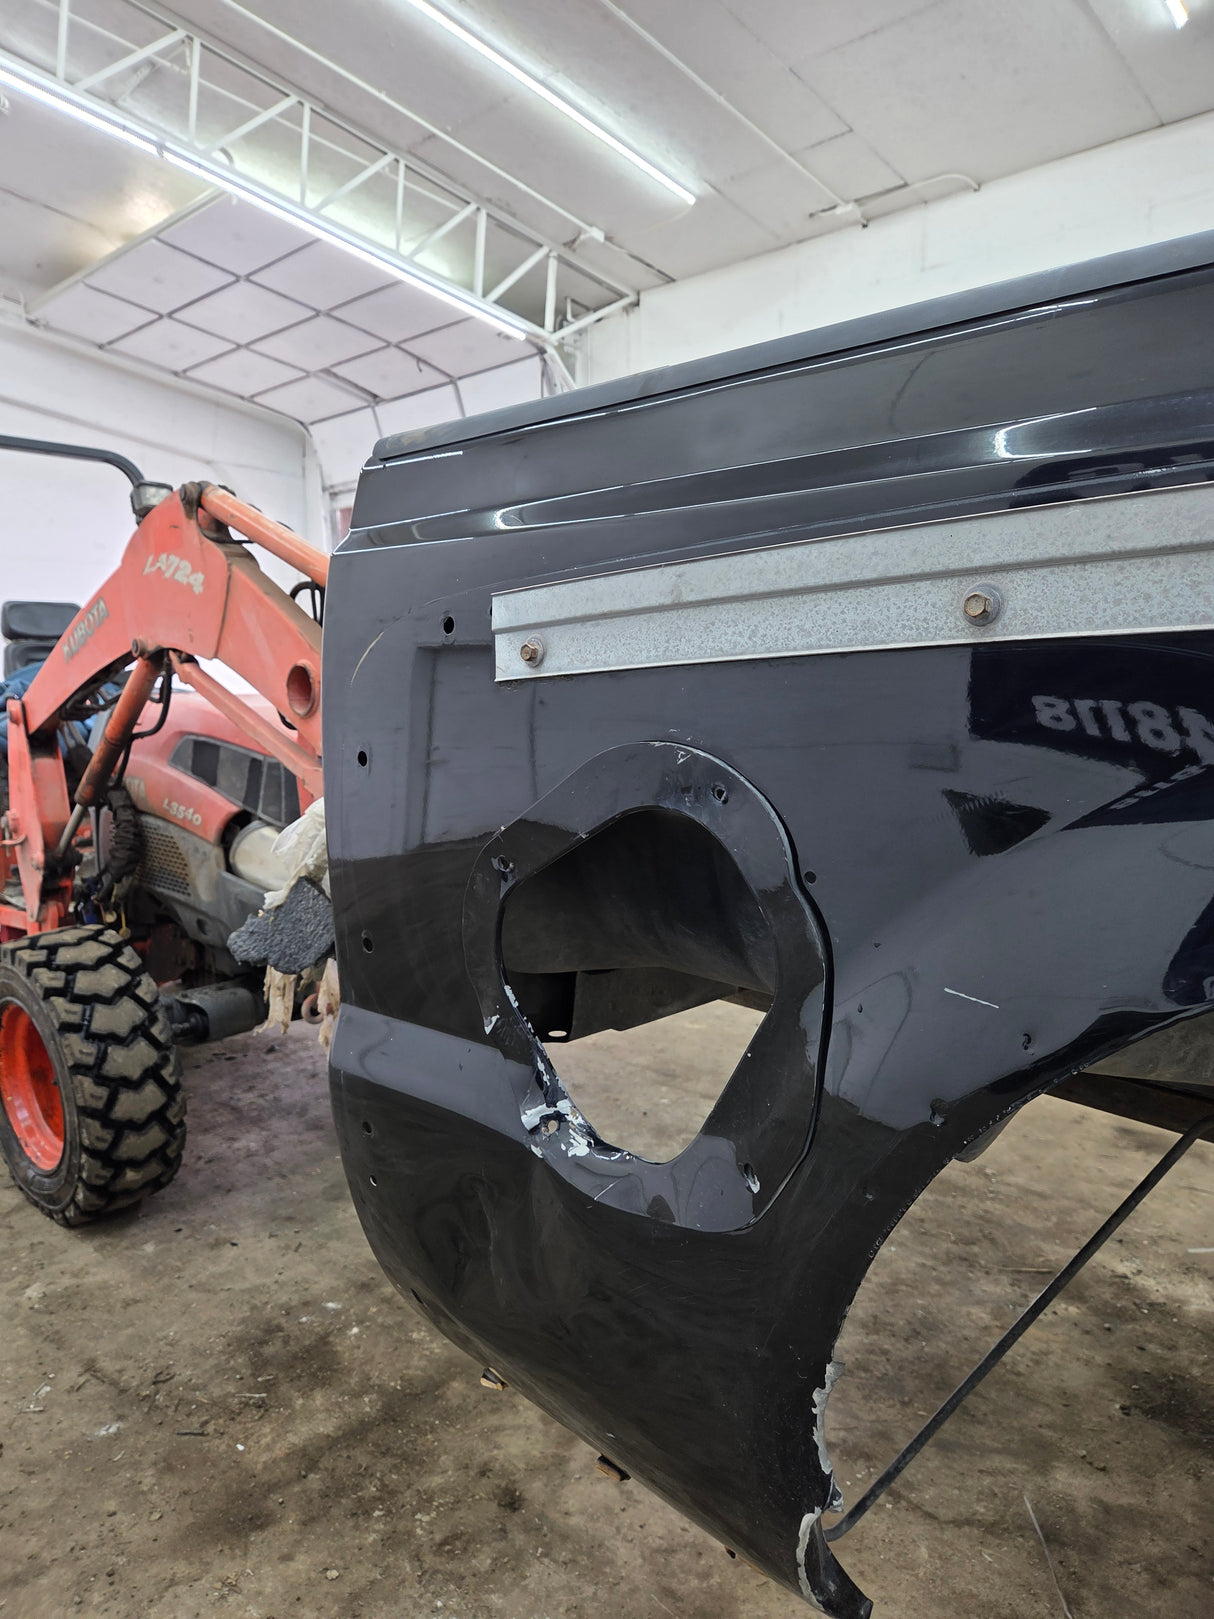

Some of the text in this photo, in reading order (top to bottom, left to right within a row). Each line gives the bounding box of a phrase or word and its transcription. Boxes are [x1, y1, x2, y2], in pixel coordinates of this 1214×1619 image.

[142, 553, 205, 595] LA724
[62, 596, 109, 663] KUBOTA
[162, 797, 203, 826] L3540
